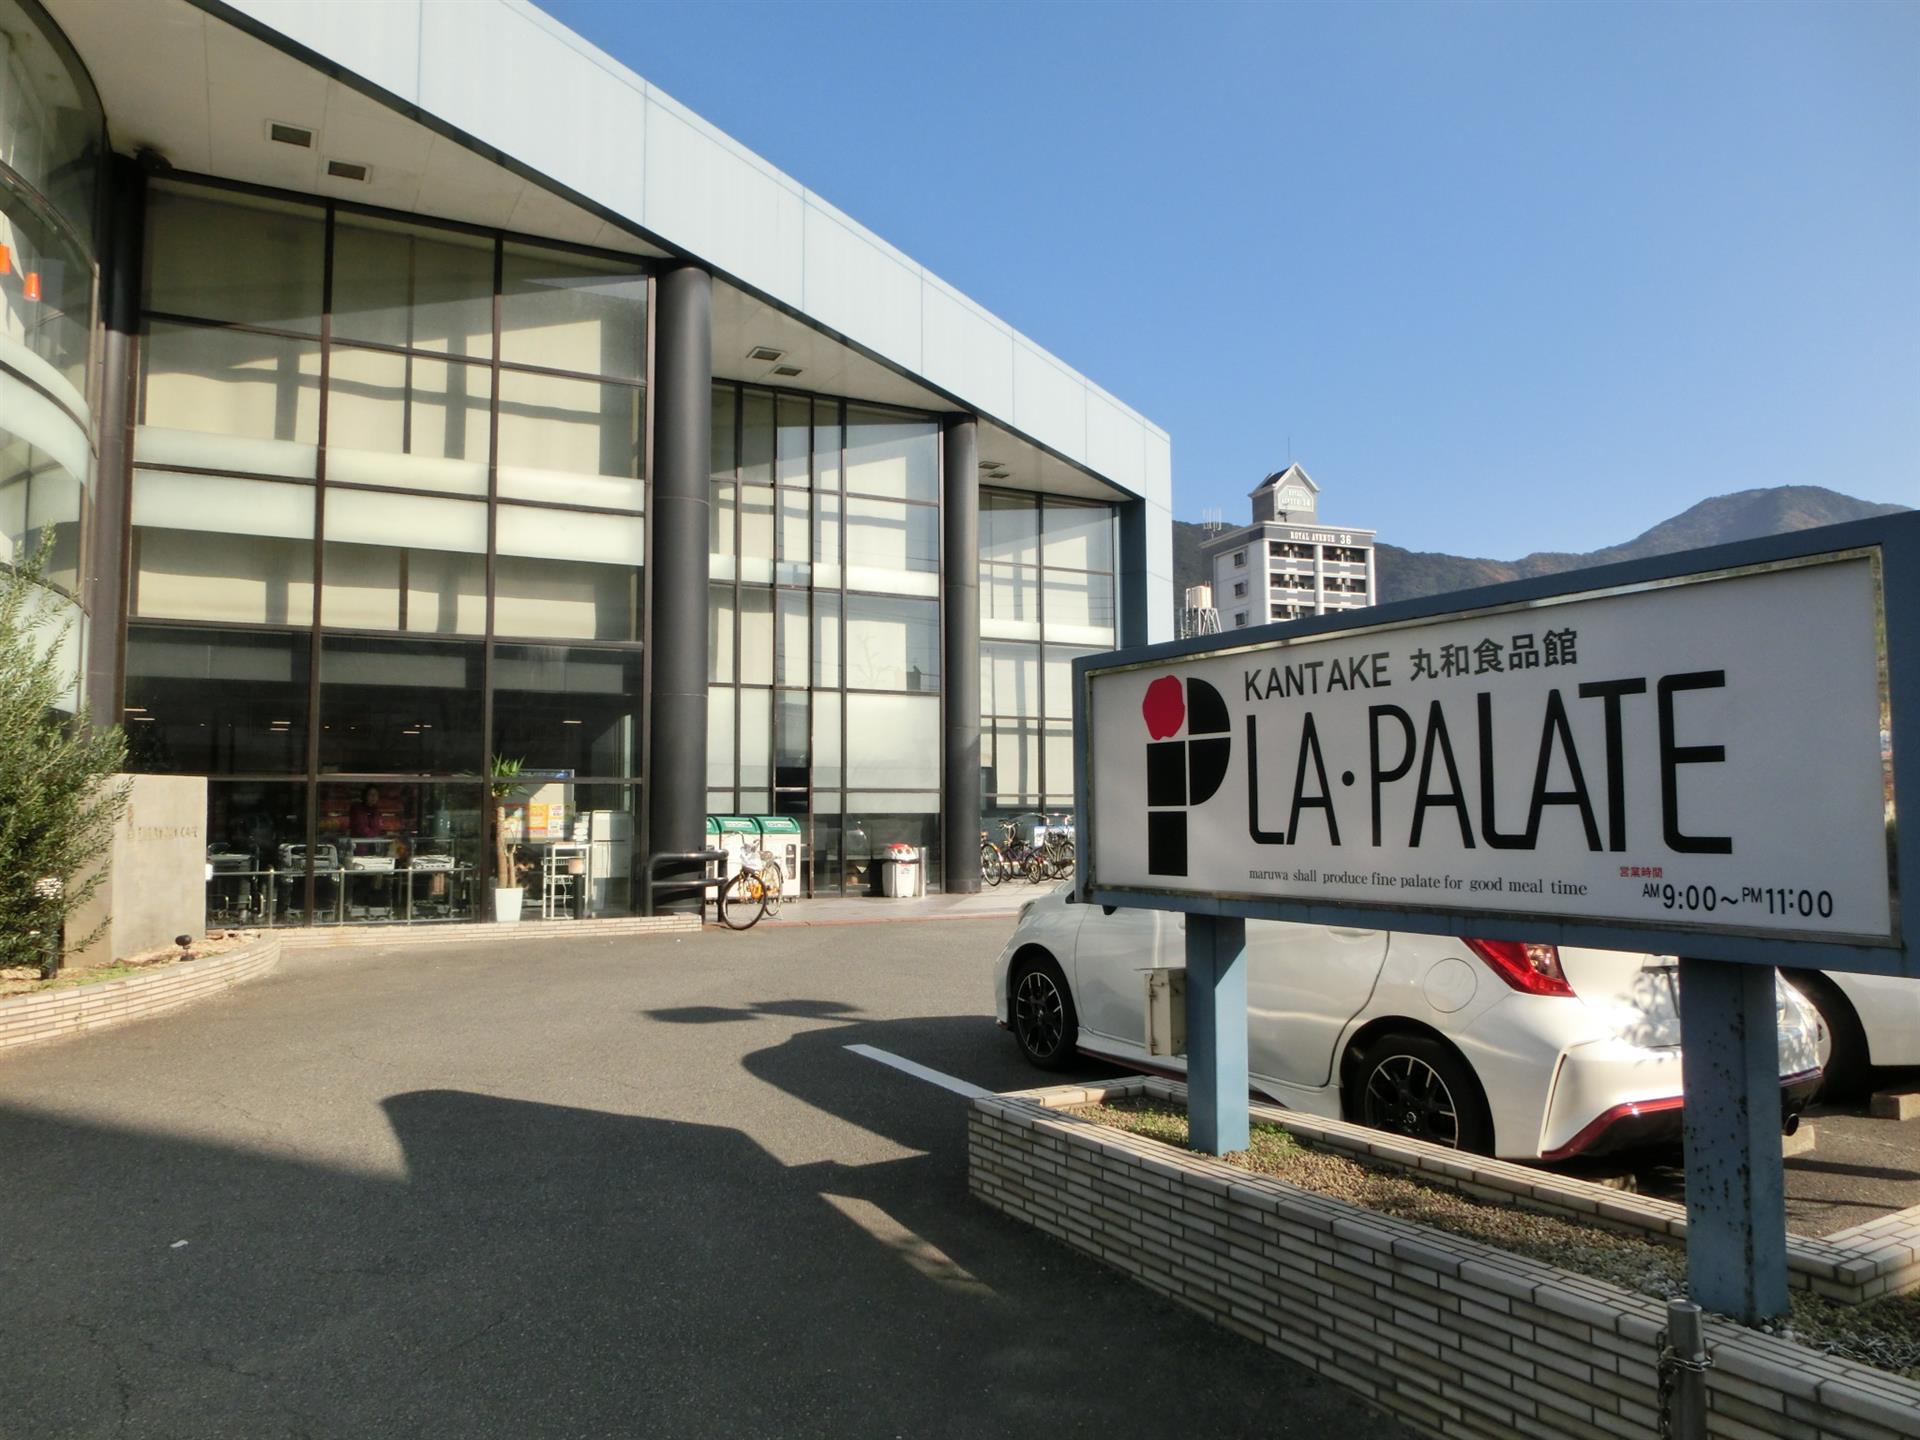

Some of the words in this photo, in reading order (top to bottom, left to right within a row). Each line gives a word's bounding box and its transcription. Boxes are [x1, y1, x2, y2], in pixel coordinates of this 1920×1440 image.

[1340, 534, 1352, 545] 36
[1244, 651, 1392, 702] KANTAKE
[1409, 627, 1578, 682] 丸和食品館
[1249, 869, 1289, 882] maruwa
[1293, 869, 1317, 883] shall
[1323, 871, 1368, 885] produce
[1371, 872, 1397, 887] fine
[1400, 874, 1441, 889] palate
[1444, 875, 1463, 891] for
[1470, 877, 1503, 893] good
[1508, 879, 1543, 894] meal
[1551, 880, 1588, 896] time
[1619, 866, 1663, 879] 営業時間
